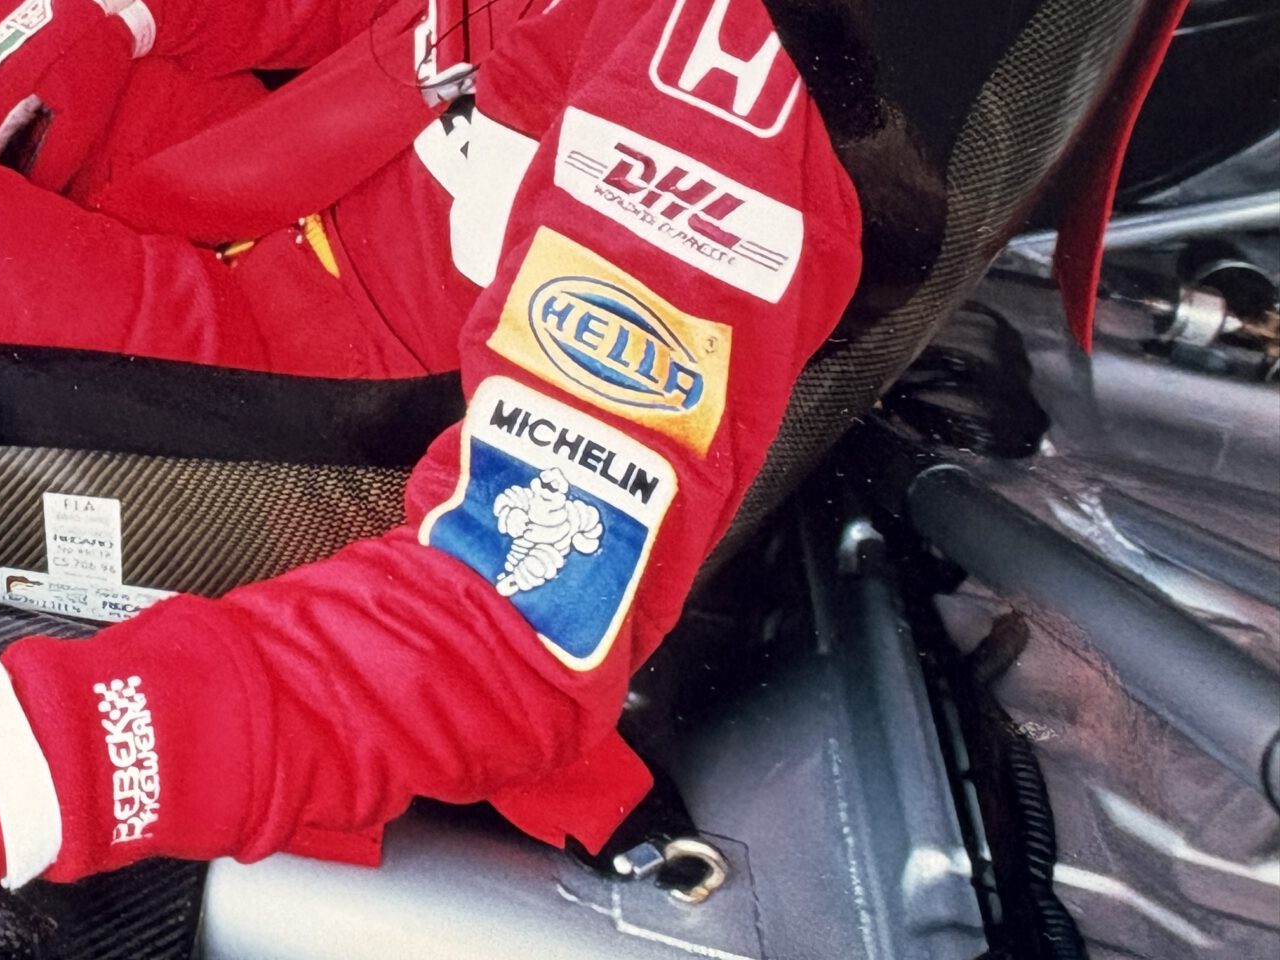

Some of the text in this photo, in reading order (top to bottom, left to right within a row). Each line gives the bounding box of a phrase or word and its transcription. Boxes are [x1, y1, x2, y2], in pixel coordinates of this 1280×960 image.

[602, 142, 745, 250] DHL
[541, 295, 704, 410] HELLA
[489, 399, 660, 505] MICHELIN
